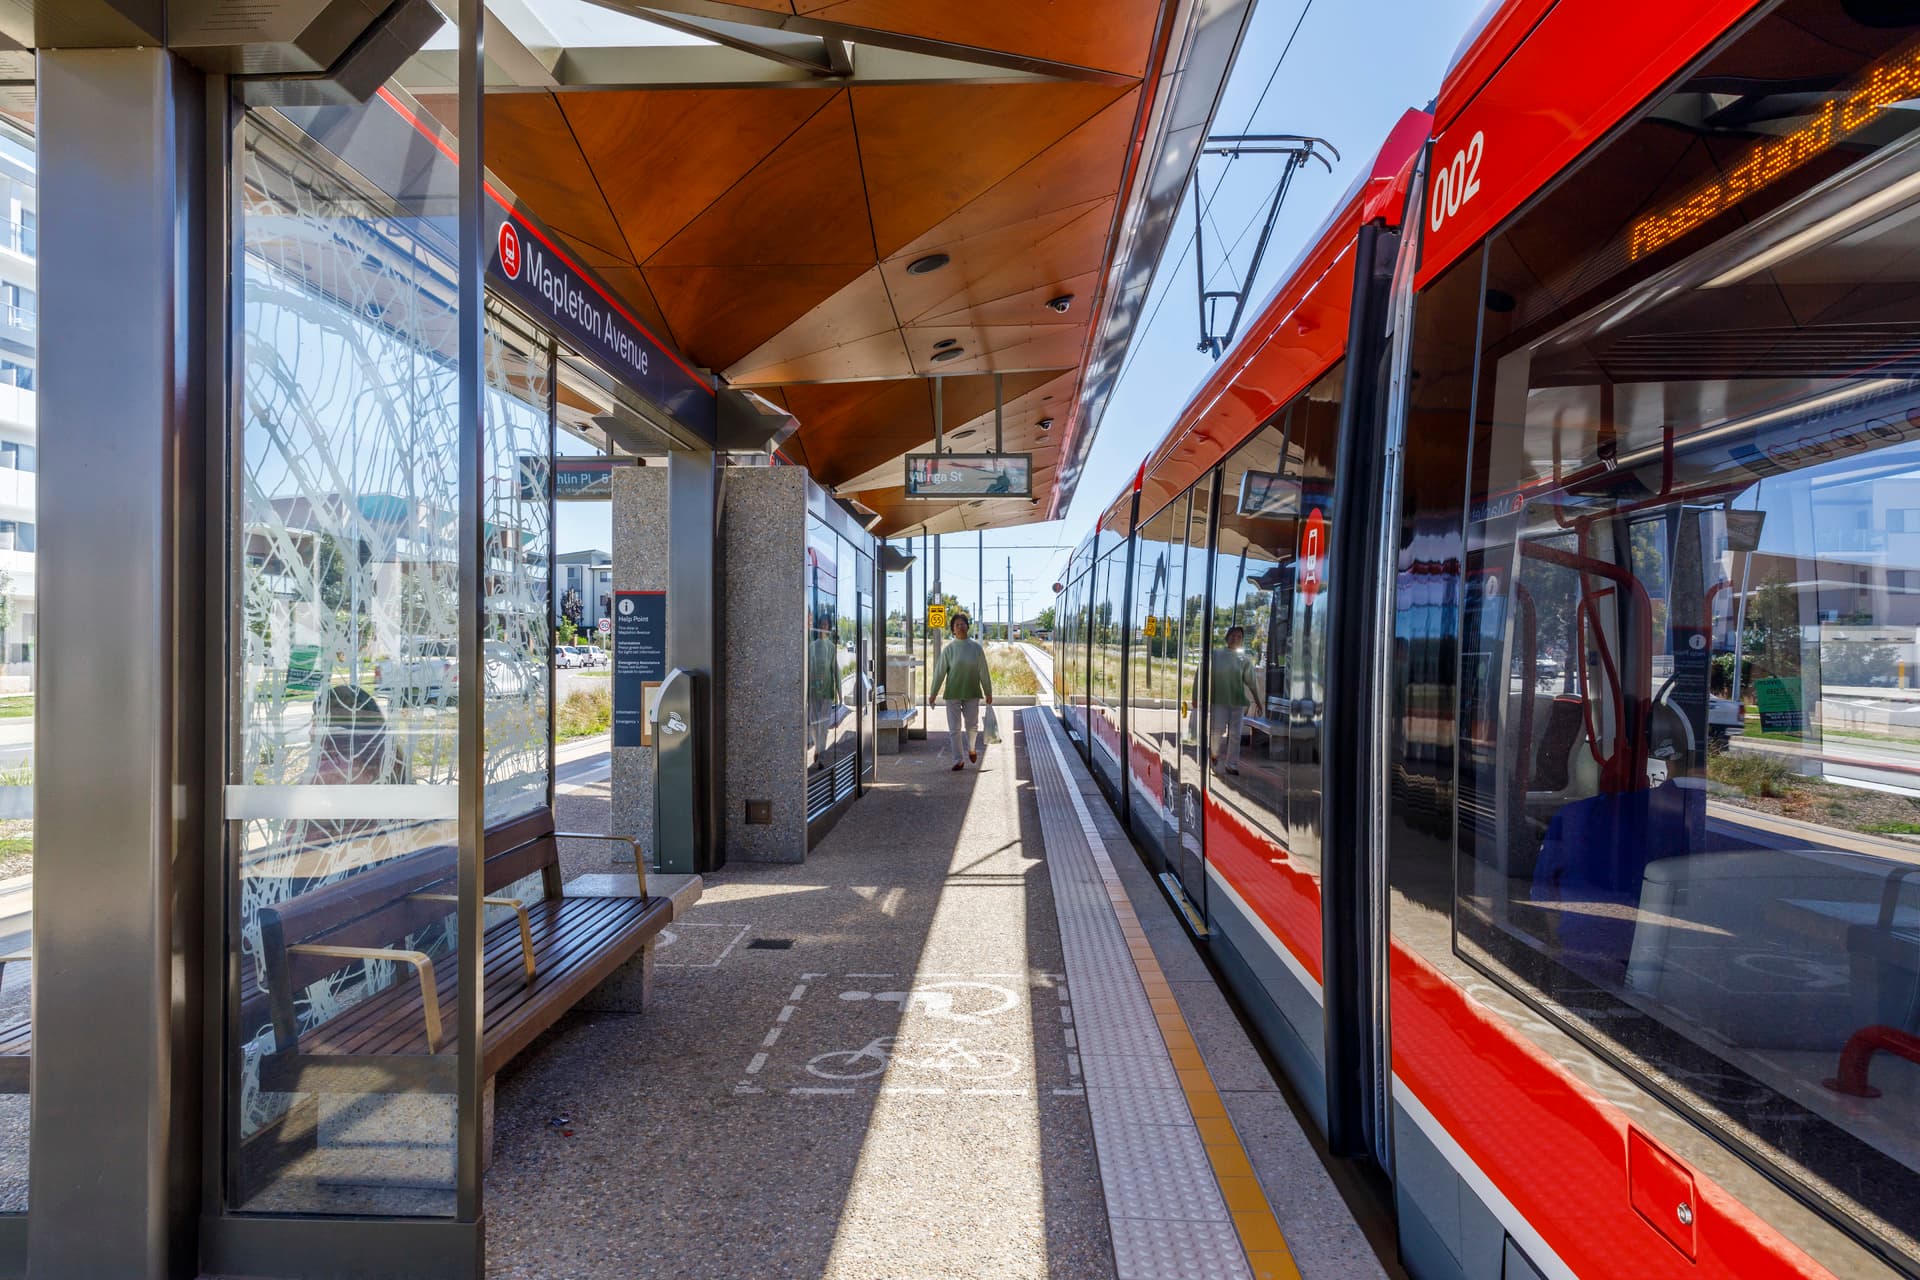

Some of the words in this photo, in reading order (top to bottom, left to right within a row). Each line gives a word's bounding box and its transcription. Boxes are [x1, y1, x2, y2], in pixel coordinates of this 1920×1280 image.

[1431, 130, 1484, 233] 002
[1631, 183, 1722, 261] Please
[1728, 98, 1835, 203] stand
[526, 241, 602, 340] Mapleton
[603, 311, 649, 376] Avenue
[950, 471, 963, 482] St
